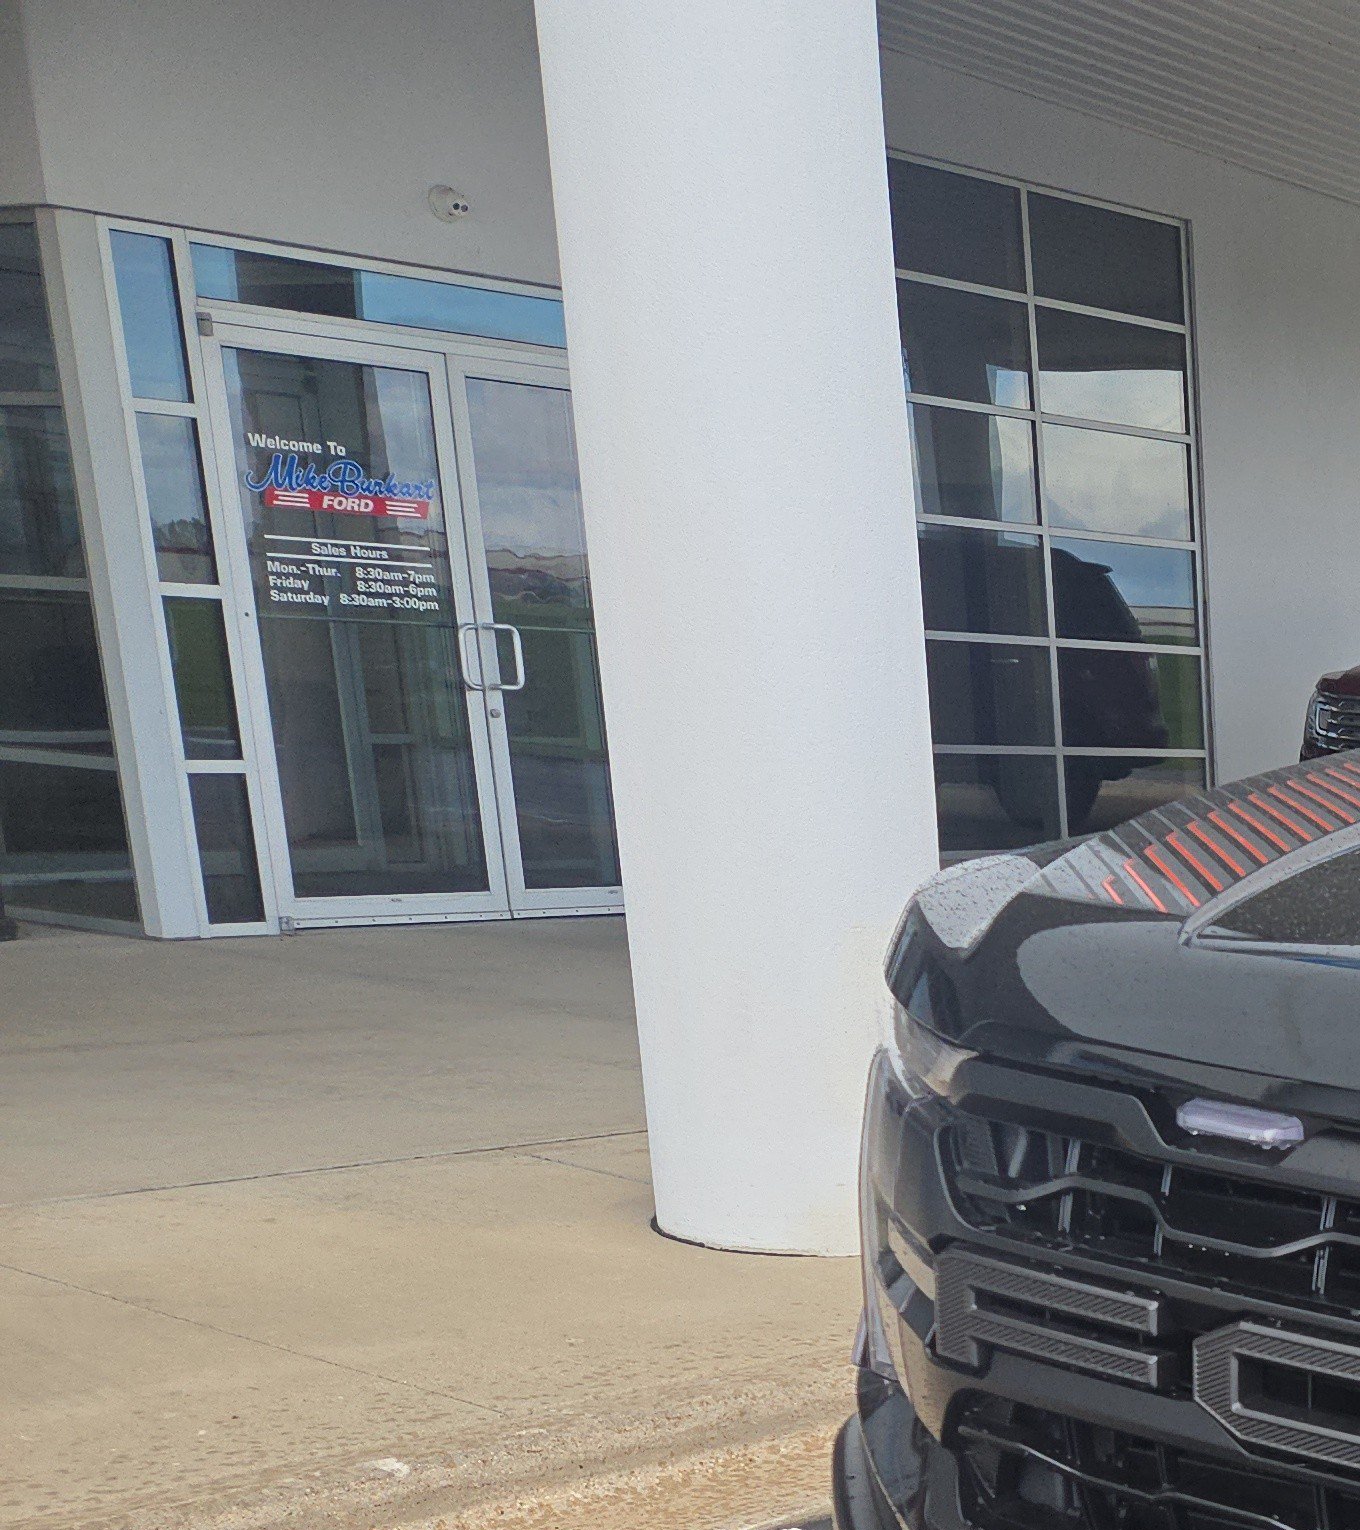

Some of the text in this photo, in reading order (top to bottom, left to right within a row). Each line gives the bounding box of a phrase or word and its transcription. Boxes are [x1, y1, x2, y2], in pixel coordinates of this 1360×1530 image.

[247, 432, 346, 456] Welcome To
[245, 453, 438, 500] Mike Burkart
[322, 495, 374, 512] FORD
[311, 542, 389, 559] Sales Hours
[266, 560, 436, 584] Mon.-Thur. 8:30am-7pm
[268, 575, 438, 598] Friday 8:30am-6pm
[269, 589, 440, 612] Saturday 8:30am-3:00pm
